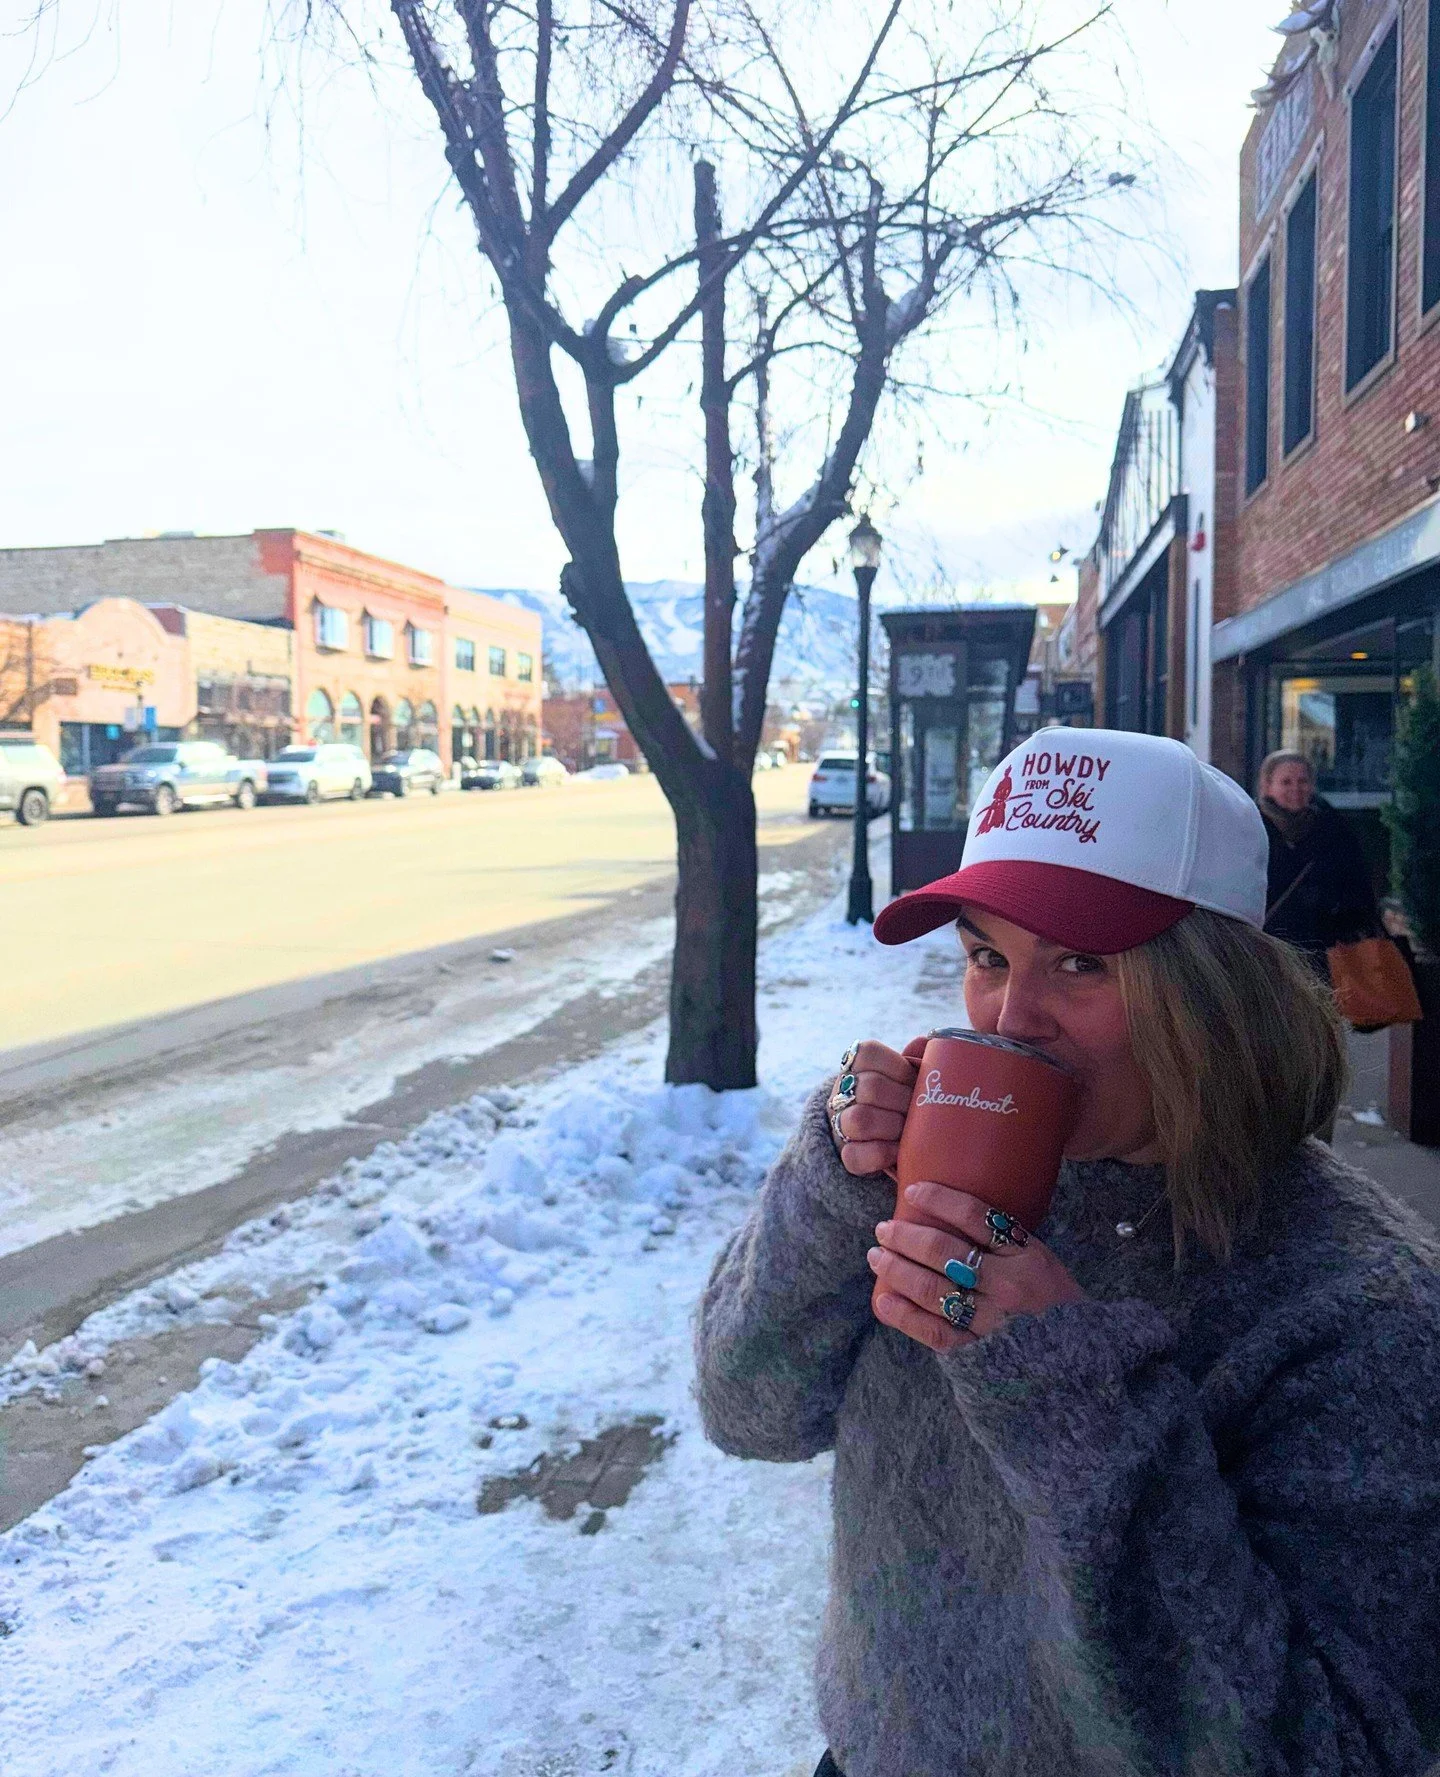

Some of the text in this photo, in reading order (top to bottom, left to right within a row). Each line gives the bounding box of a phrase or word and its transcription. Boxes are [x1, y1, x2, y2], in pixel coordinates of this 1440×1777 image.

[1021, 752, 1111, 781] HOWDY
[1024, 778, 1094, 811] FROM Ski
[1005, 801, 1101, 844] Country
[916, 1069, 1019, 1115] Steamboat
